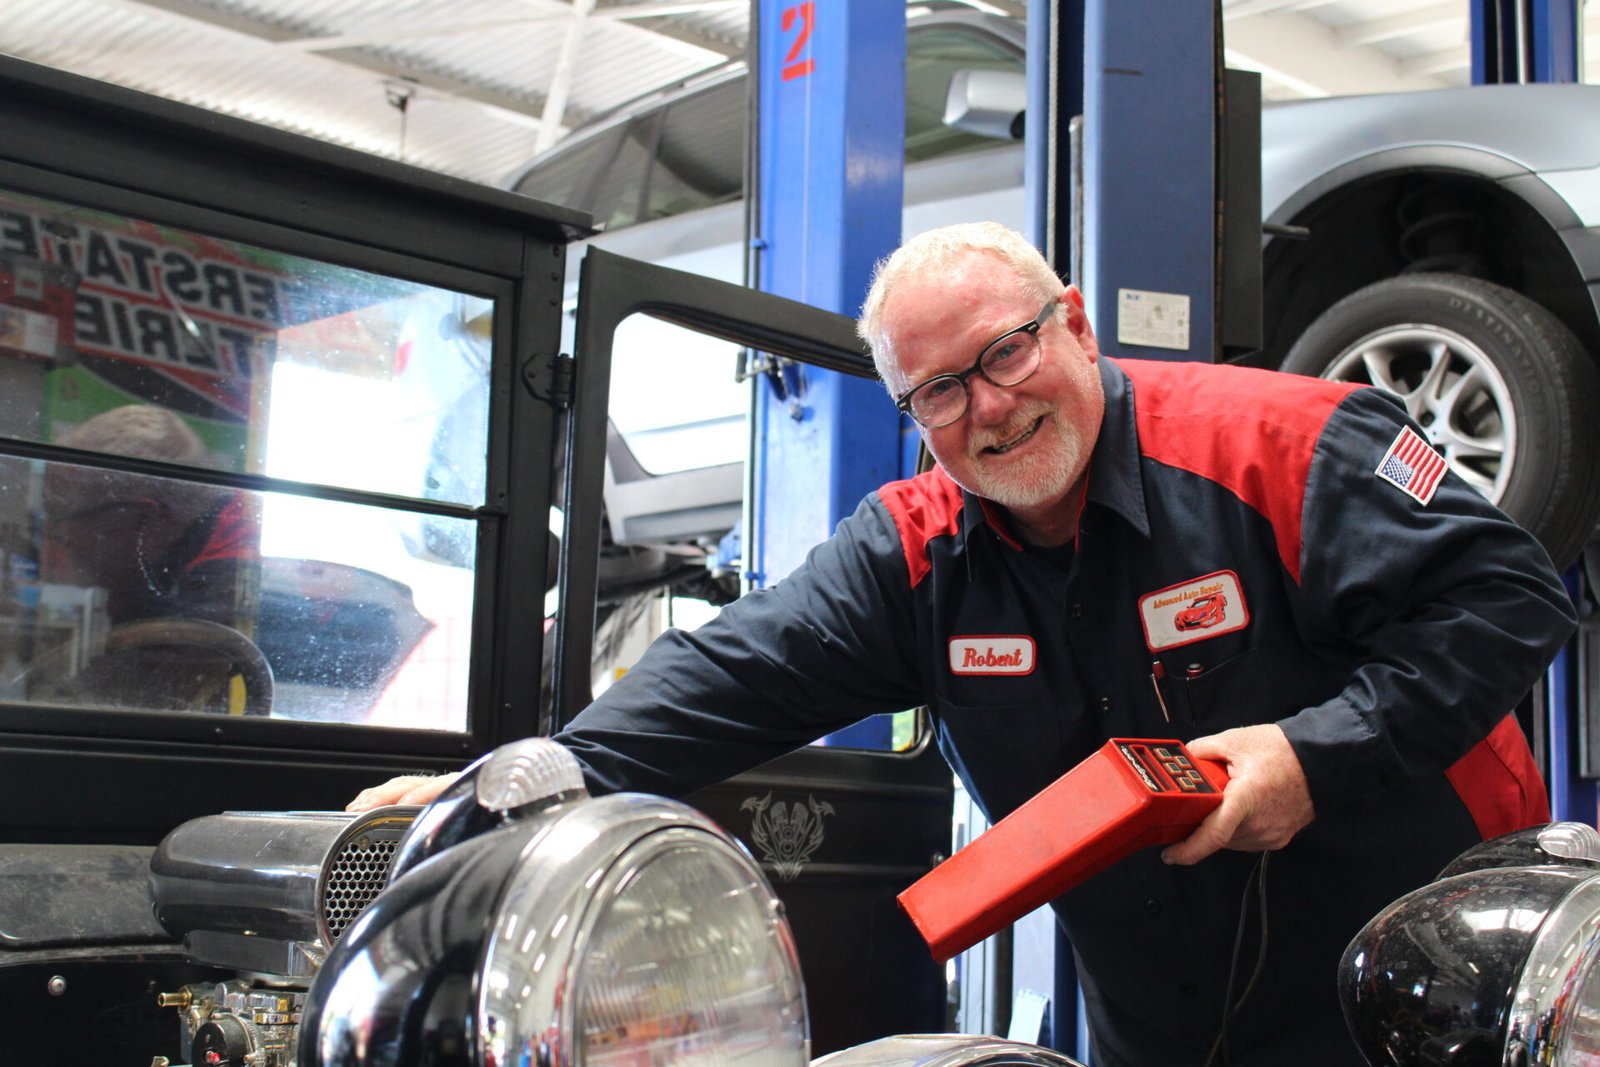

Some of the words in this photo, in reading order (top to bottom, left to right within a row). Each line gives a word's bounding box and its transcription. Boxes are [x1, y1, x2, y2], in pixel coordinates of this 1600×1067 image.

[781, 0, 816, 82] 2
[1183, 589, 1200, 601] Auto
[1200, 582, 1224, 596] Repair
[962, 647, 1023, 668] Robert
